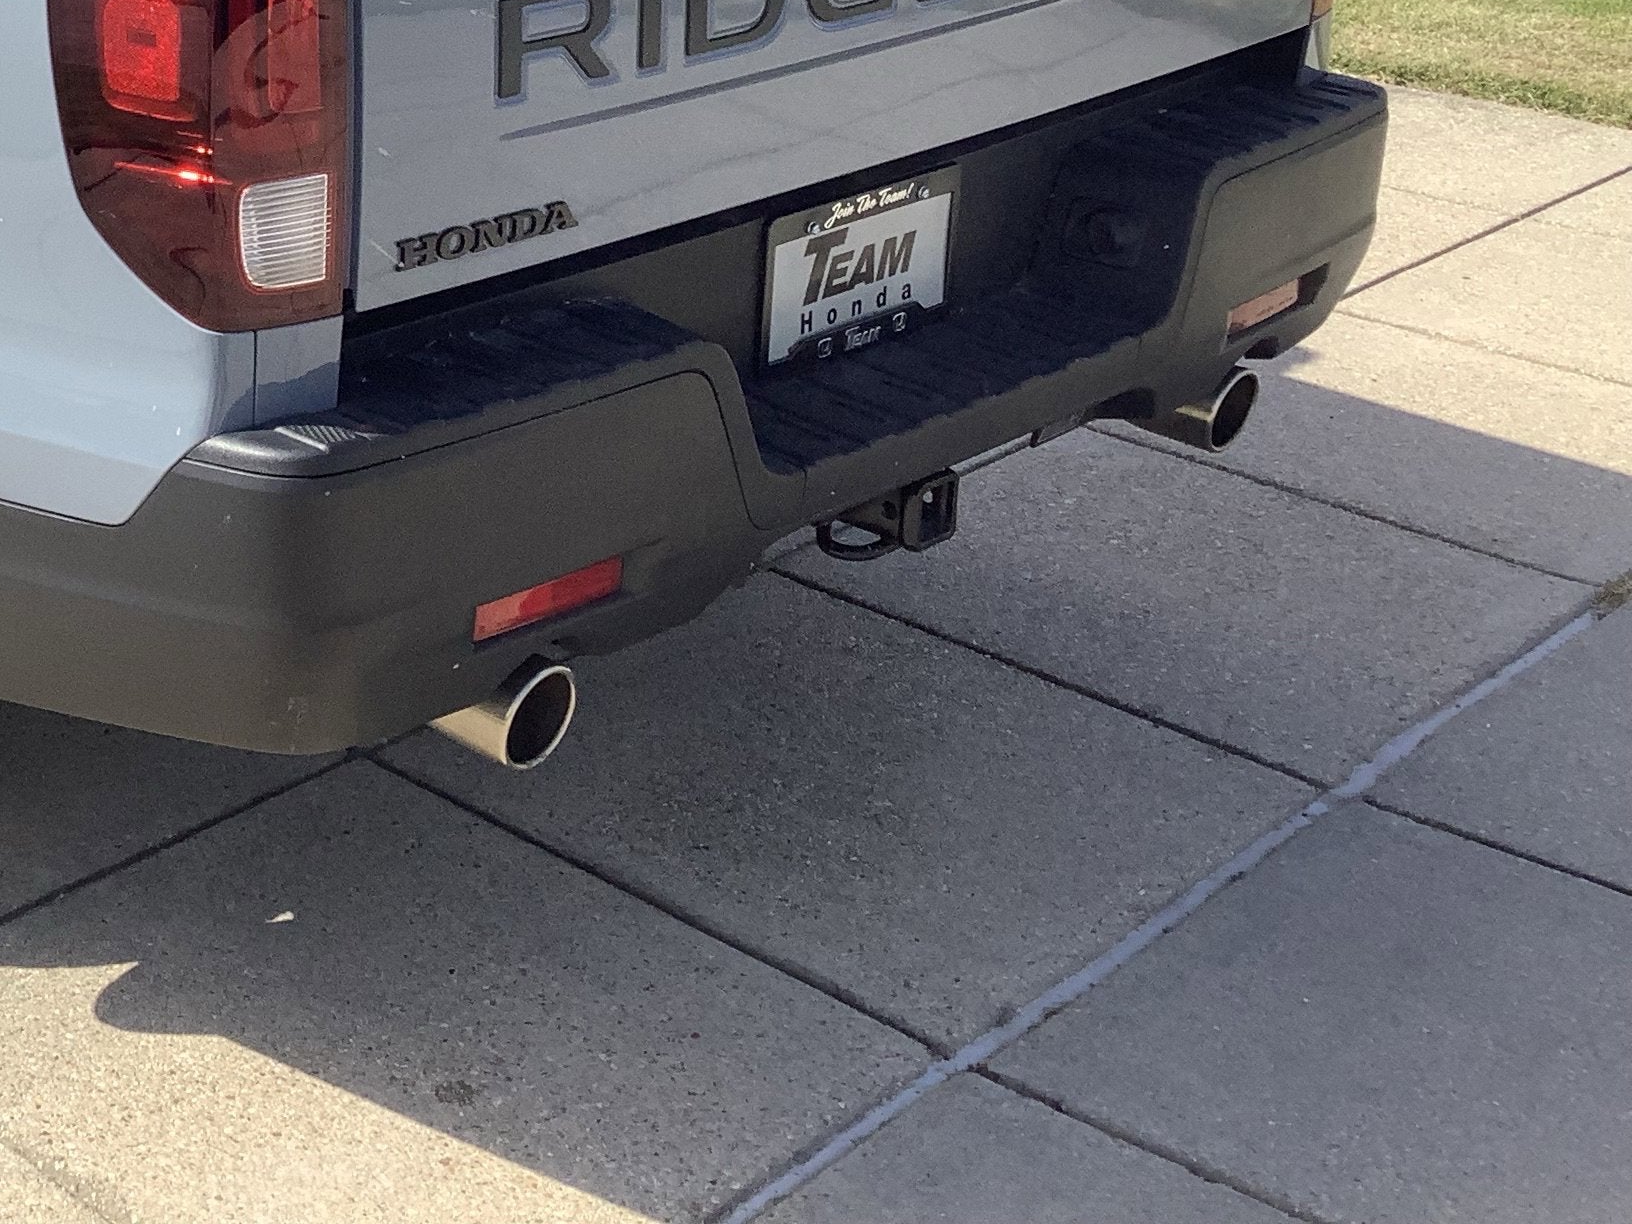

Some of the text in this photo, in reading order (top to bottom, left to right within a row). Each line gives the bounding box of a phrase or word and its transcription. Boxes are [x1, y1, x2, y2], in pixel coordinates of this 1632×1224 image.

[394, 200, 579, 272] HONDA
[824, 182, 914, 229] Join The Team!
[802, 226, 917, 306] TEAM
[800, 283, 911, 334] Honda
